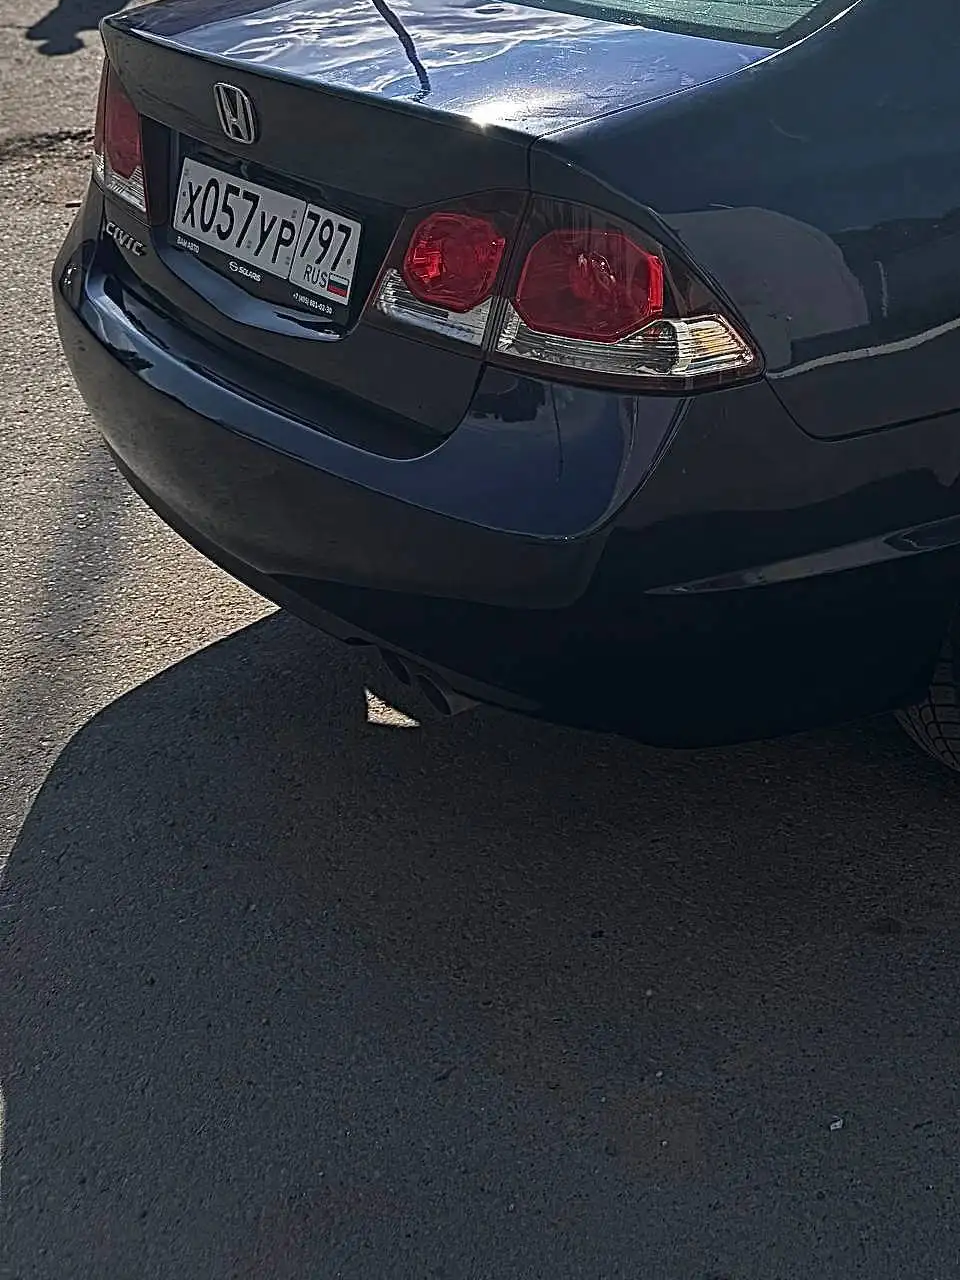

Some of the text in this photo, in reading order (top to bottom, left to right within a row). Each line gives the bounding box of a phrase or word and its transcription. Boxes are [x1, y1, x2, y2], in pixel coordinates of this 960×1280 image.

[105, 222, 144, 257] CIVIC
[300, 210, 352, 272] 797
[304, 264, 328, 289] RUS
